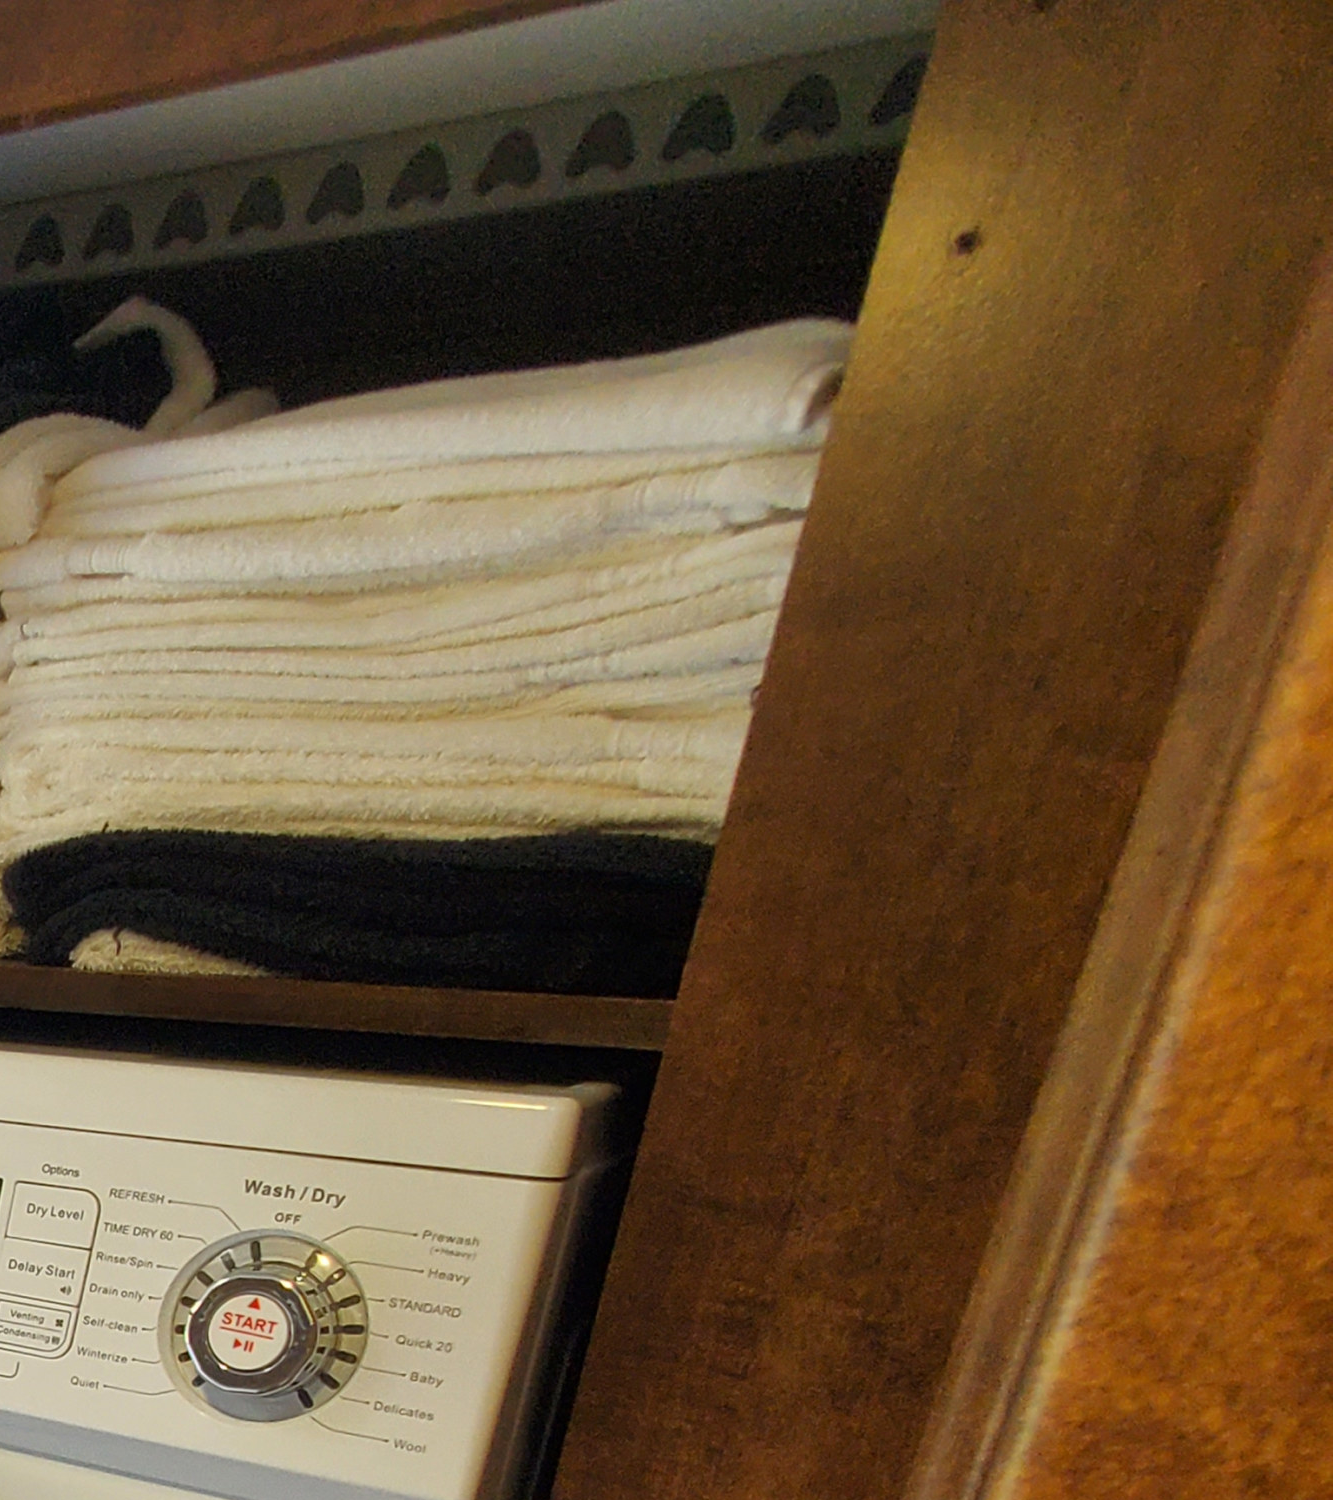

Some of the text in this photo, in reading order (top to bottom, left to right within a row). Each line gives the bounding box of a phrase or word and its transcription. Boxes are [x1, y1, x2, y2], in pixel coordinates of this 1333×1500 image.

[41, 1163, 81, 1179] Options
[108, 1187, 165, 1205] REFRESH
[244, 1179, 296, 1200] Wash
[311, 1188, 346, 1209] Dry
[26, 1202, 85, 1221] Dry Level
[274, 1212, 302, 1225] OFF
[103, 1221, 174, 1242] TIME DRY 60
[421, 1229, 480, 1248] Prewash
[7, 1258, 76, 1280] Delay Start
[96, 1250, 154, 1270] Rinse/Spin
[427, 1267, 471, 1286] Heavy
[89, 1282, 146, 1303] Drain only
[9, 1308, 45, 1326] Venting
[388, 1297, 462, 1319] STANDARD
[83, 1315, 139, 1333] Self-clean
[221, 1311, 278, 1335] START
[395, 1334, 454, 1354] Quick 20
[76, 1346, 129, 1364] Winterize
[70, 1375, 100, 1390] Quiet
[409, 1371, 445, 1389] Baby
[373, 1400, 435, 1421] Delicates
[393, 1438, 427, 1454] Wool
